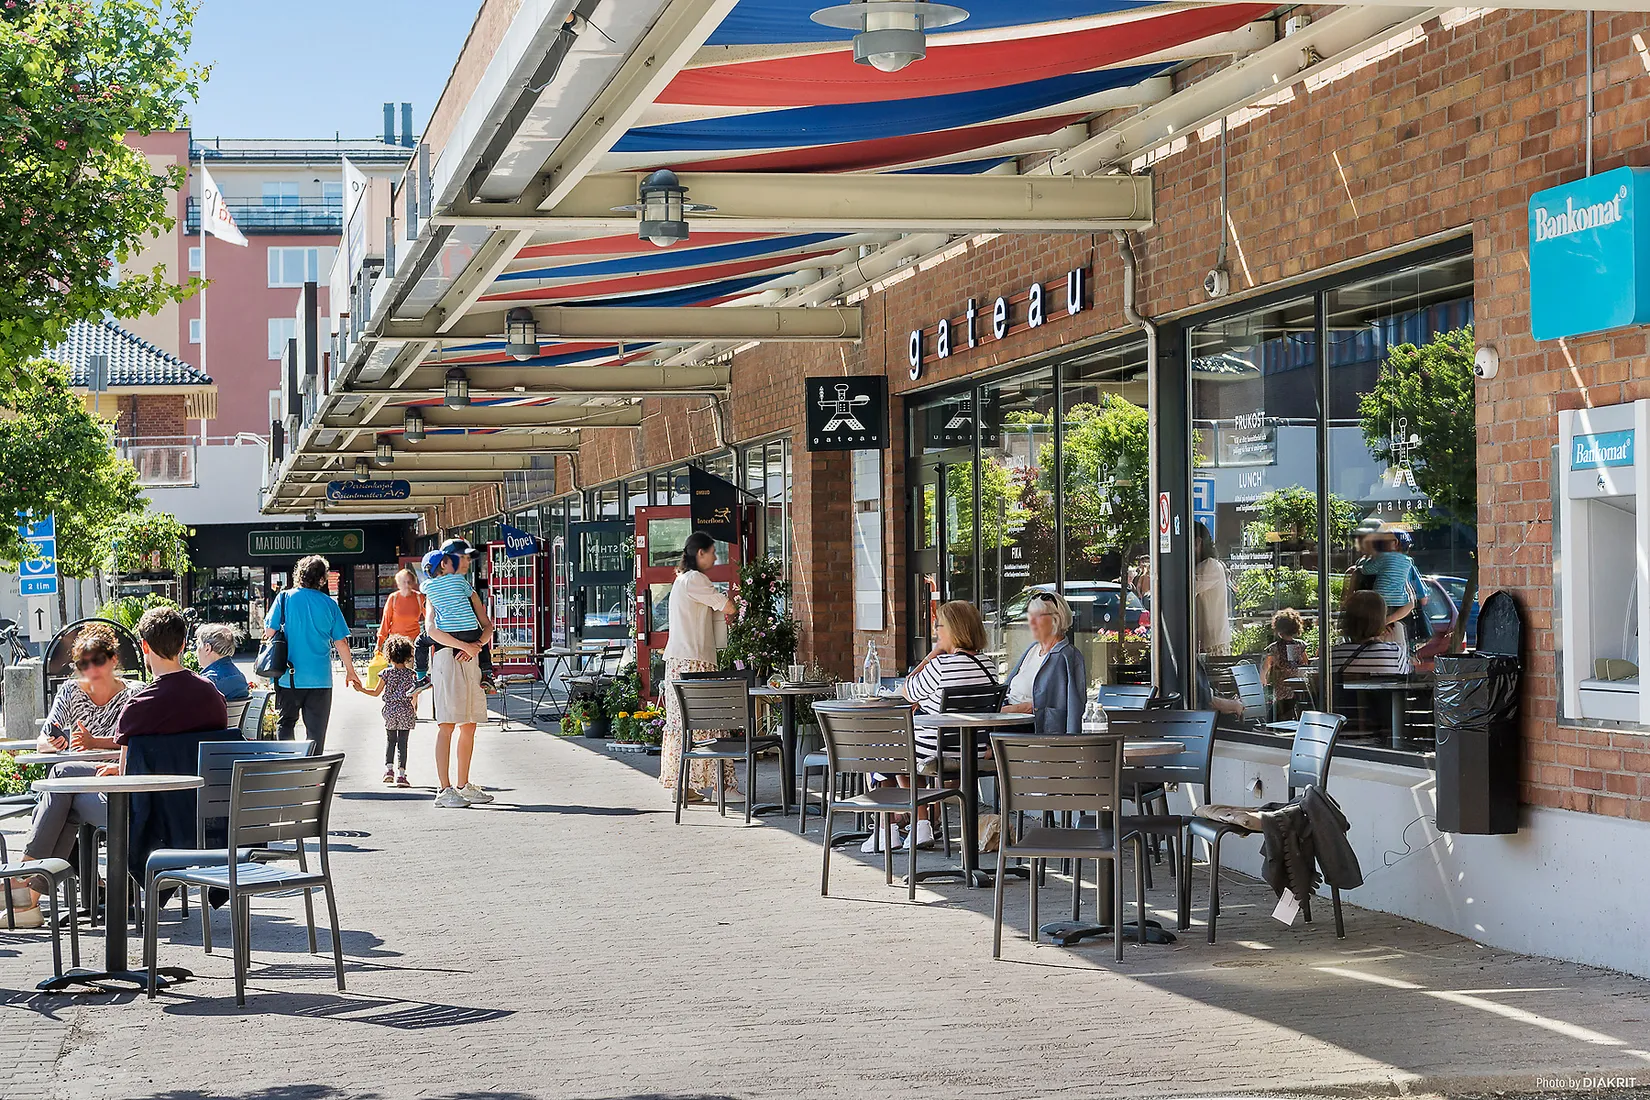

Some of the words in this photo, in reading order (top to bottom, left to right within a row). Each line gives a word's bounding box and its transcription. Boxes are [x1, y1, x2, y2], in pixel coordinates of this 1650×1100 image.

[908, 267, 1085, 381] gateau
[1234, 411, 1266, 430] FRUKOST
[813, 434, 877, 445] gateau
[1239, 471, 1262, 488] LUNCH
[1376, 499, 1433, 515] gateau
[255, 535, 302, 550] MATBODEN
[1243, 531, 1260, 546] FIKA
[1011, 547, 1023, 560] FIKA
[36, 582, 50, 590] tim
